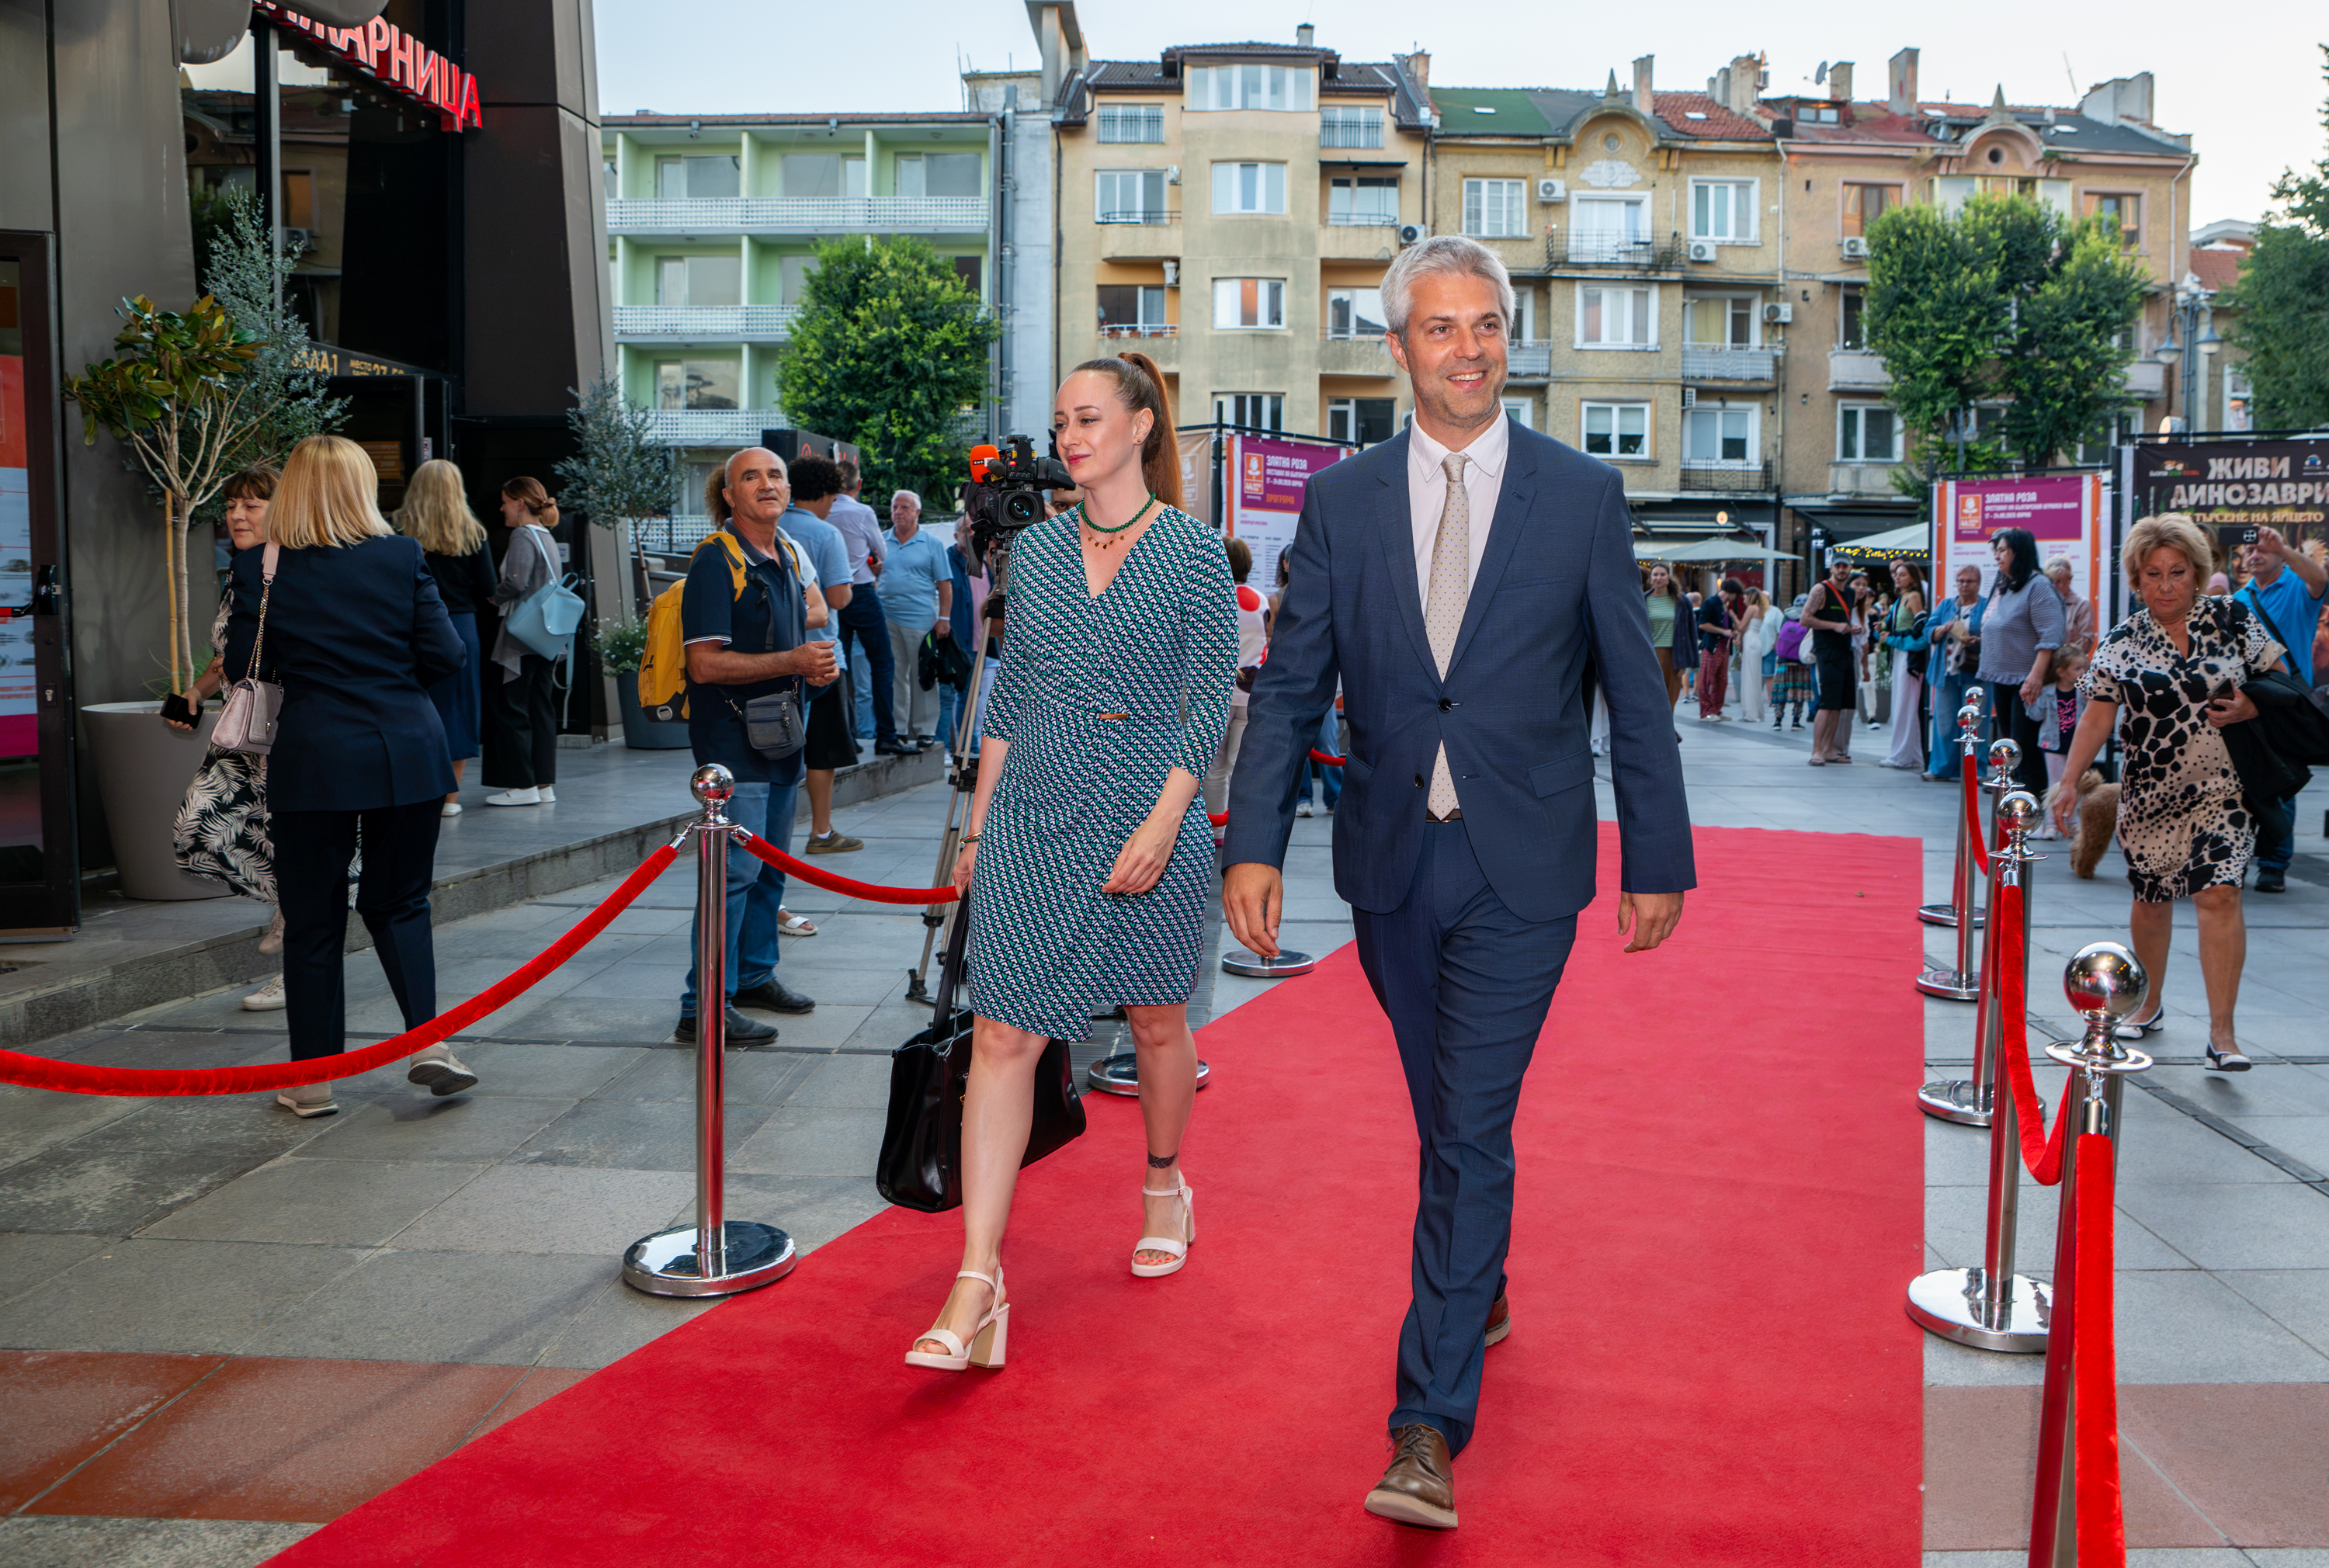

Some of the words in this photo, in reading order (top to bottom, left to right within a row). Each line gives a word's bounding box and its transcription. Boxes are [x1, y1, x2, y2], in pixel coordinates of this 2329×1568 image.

[331, 354, 338, 376] 1
[1266, 455, 1290, 468] ЗЛАТНА
[1291, 458, 1307, 470] РОЗА
[2206, 456, 2290, 480] ЖИВИ
[1266, 493, 1295, 505] ПРОГРАМА
[1984, 493, 2015, 504] ЗЛАТНА
[2015, 491, 2037, 503] РОЗА
[2170, 481, 2329, 509] ДИНОЗАВРИ
[2195, 512, 2248, 522] ТЪРСЕНЕ
[2251, 512, 2268, 522] НА
